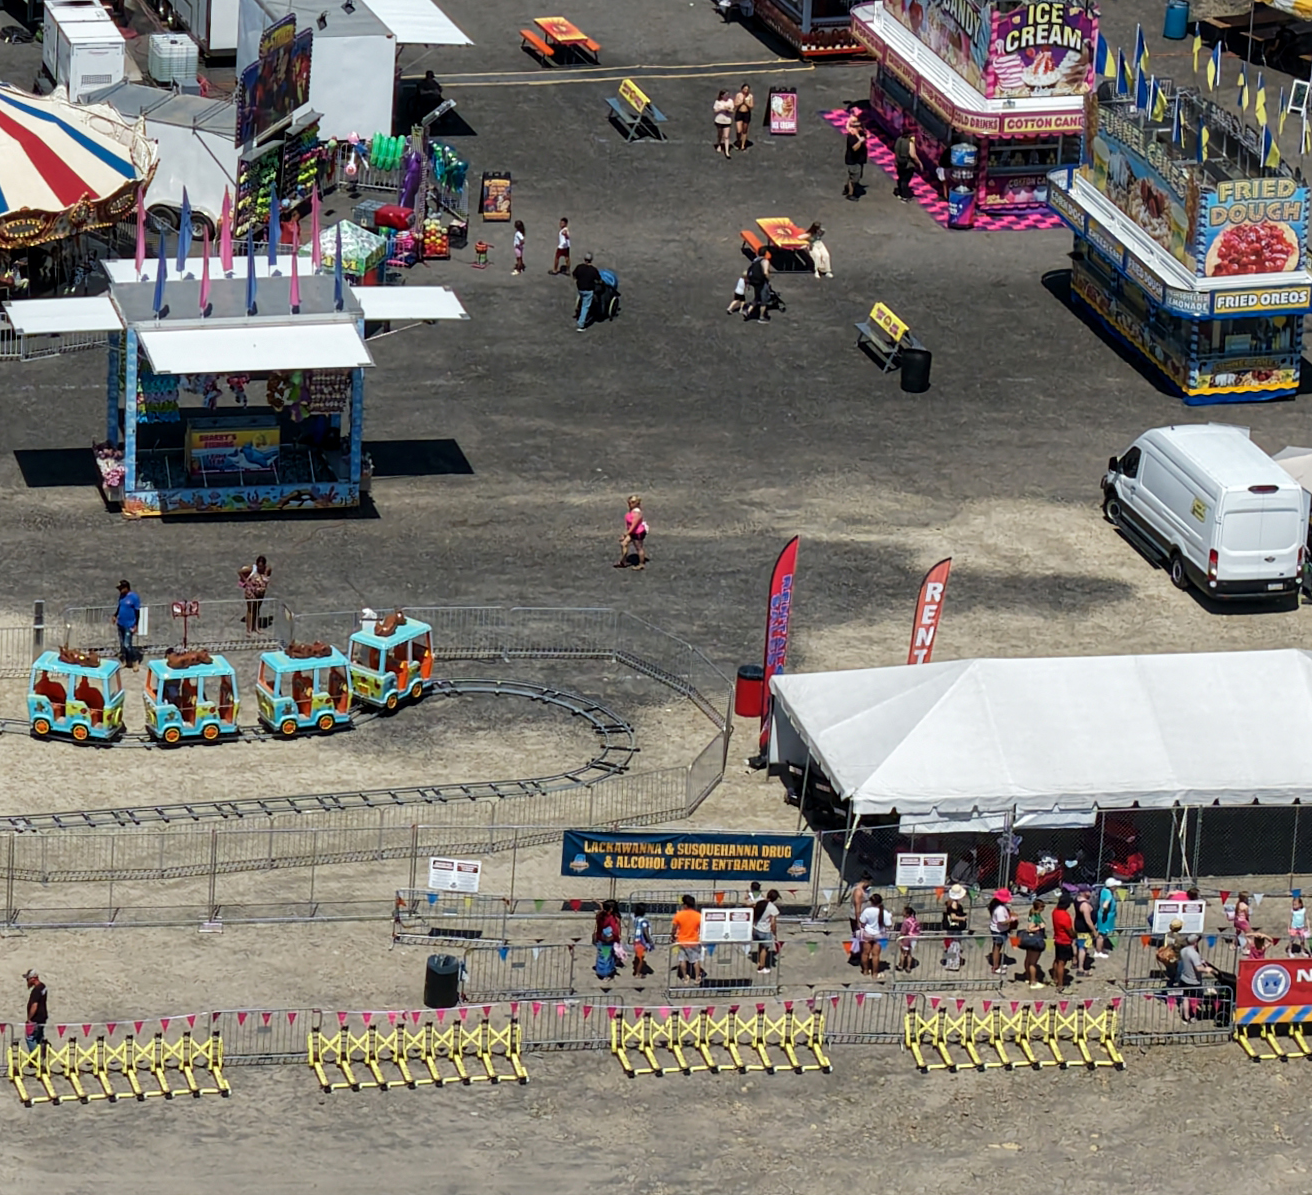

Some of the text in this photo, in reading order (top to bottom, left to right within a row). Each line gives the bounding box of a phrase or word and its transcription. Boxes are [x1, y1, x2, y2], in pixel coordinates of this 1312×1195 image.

[1027, 3, 1065, 25] ICE
[1004, 24, 1083, 53] CREAM
[970, 119, 998, 131] DRINKS
[1007, 116, 1084, 130] COTTON CAND
[1217, 177, 1298, 203] FRIED
[1209, 201, 1303, 227] DOUGH
[1217, 291, 1308, 309] FRIED OREOS
[584, 840, 792, 858] LACKAWANNA & SUSQUEHANNA DRUG
[603, 855, 770, 872] & ALCOHOL OFFICE ENTRANCE
